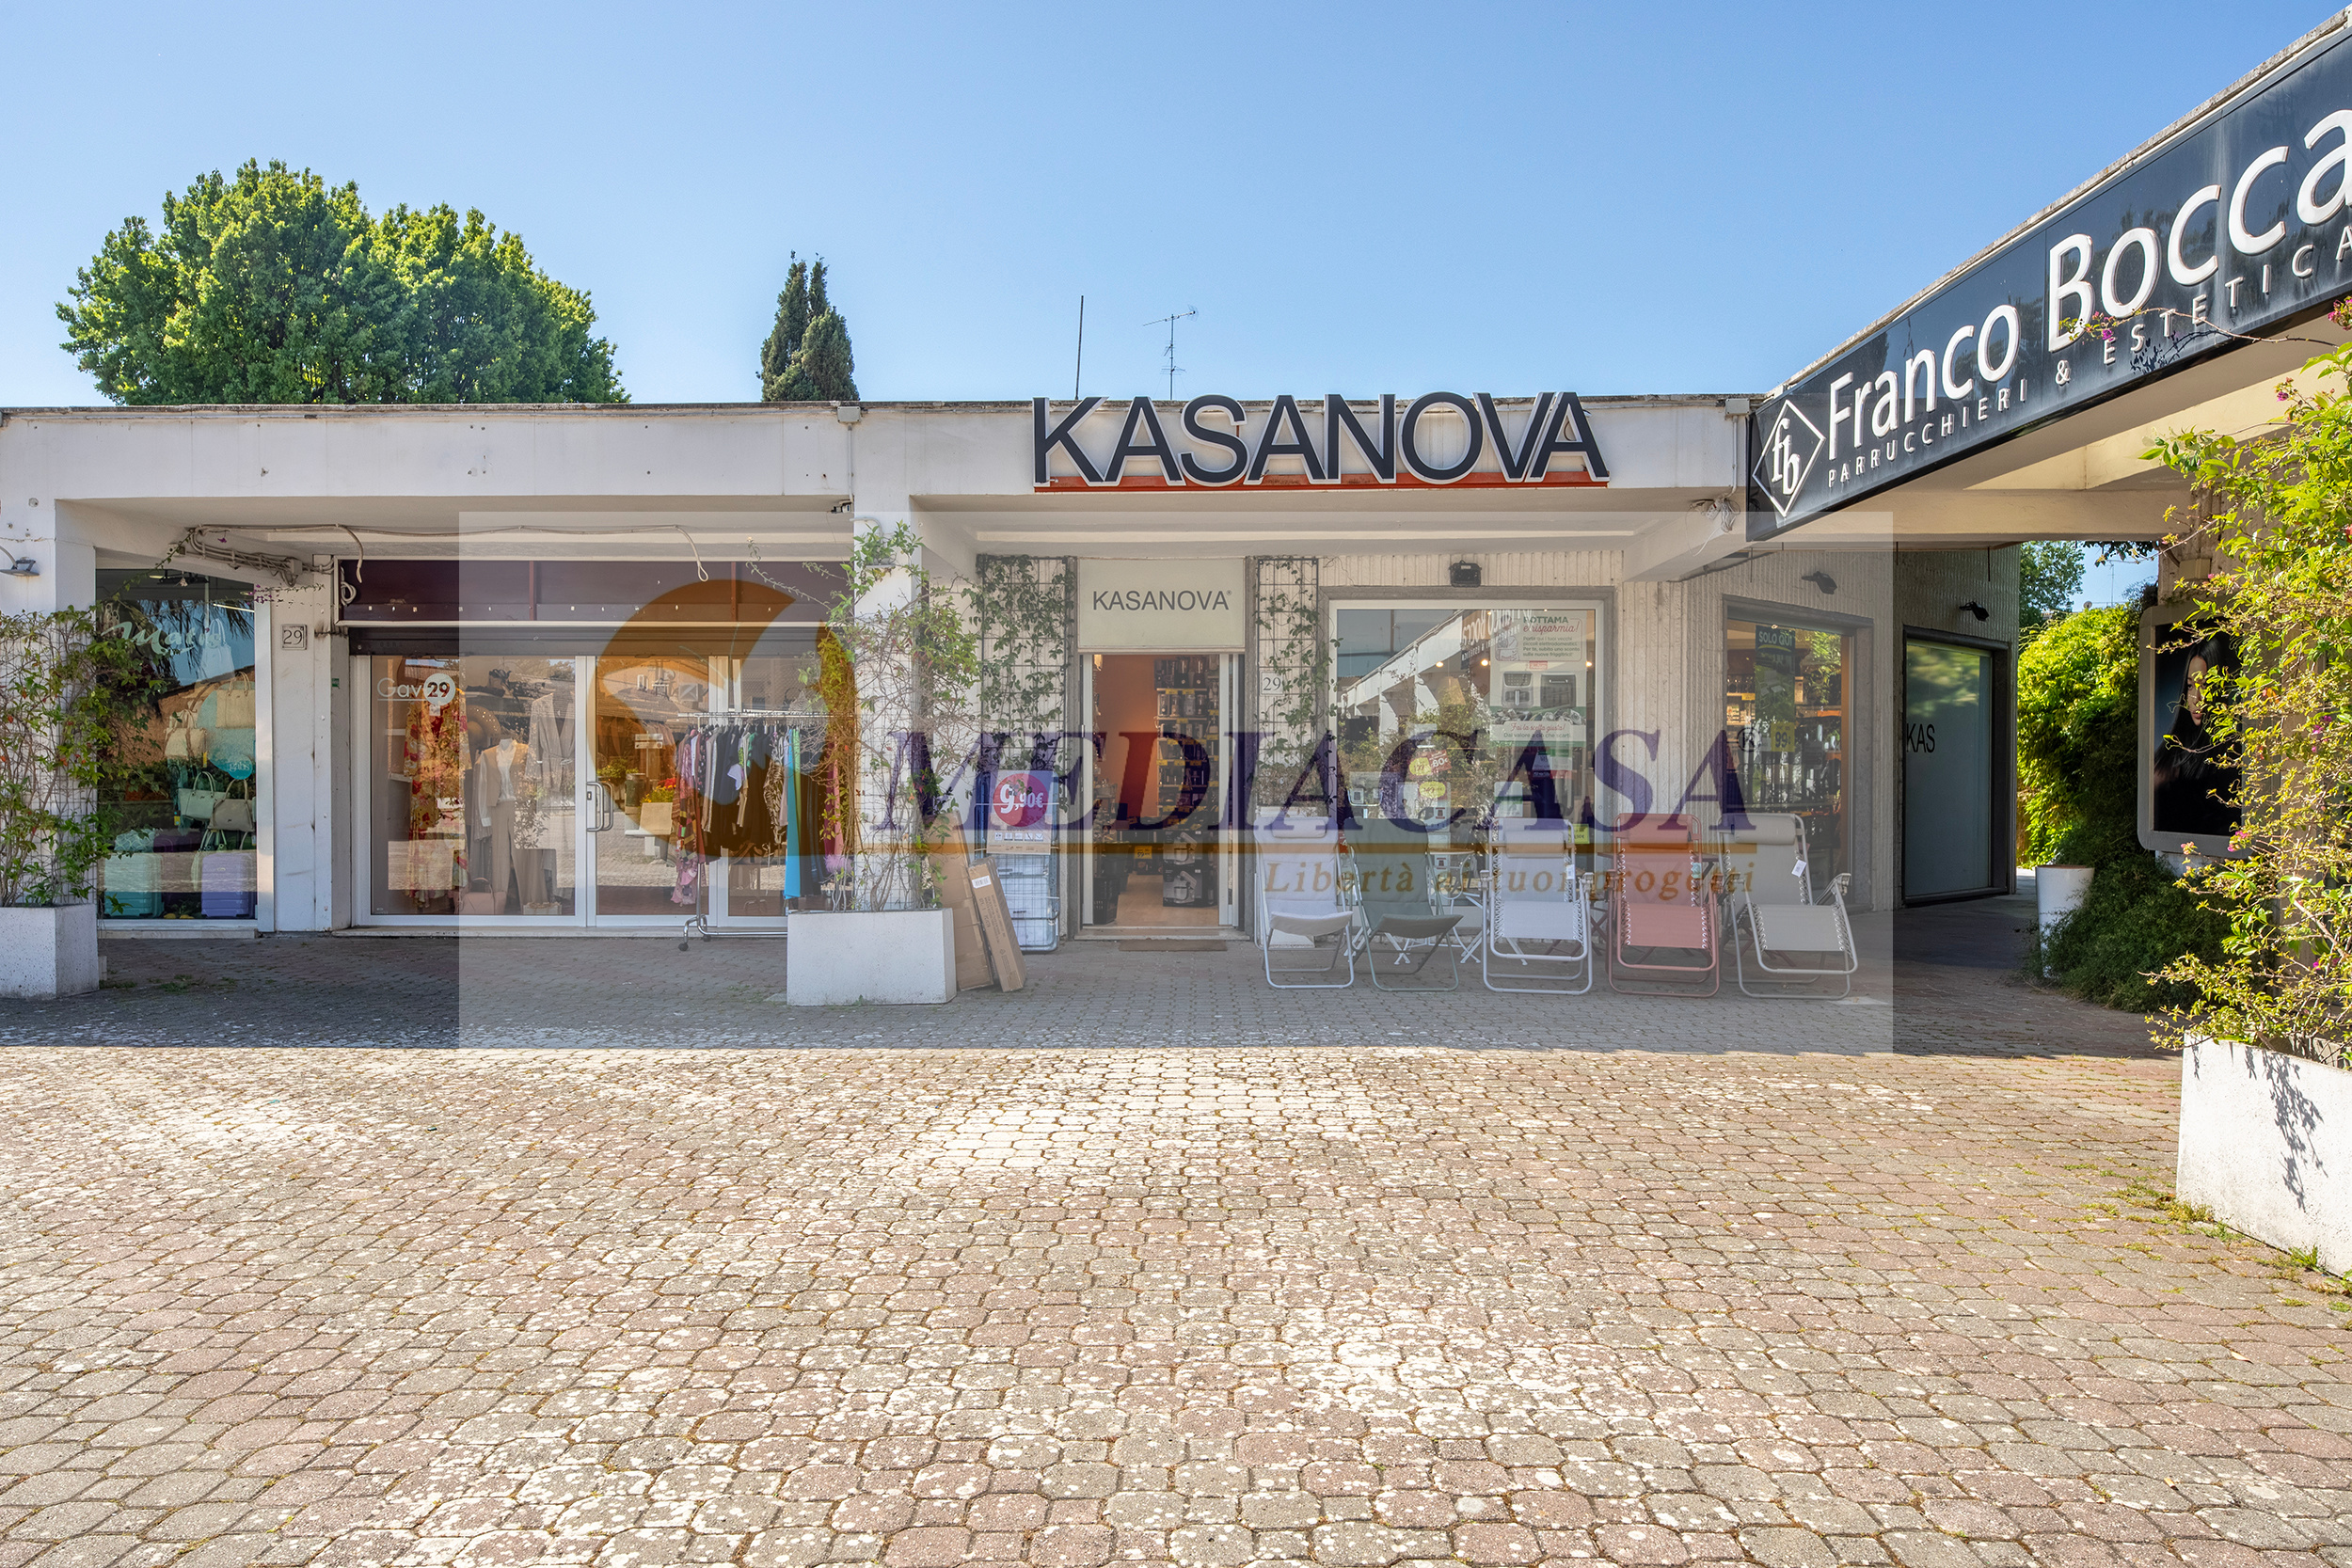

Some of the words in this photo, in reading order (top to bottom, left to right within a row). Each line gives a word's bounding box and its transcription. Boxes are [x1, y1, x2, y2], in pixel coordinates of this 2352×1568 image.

[1828, 303, 2021, 461] Franco
[2047, 108, 2352, 354] Bocca
[1827, 378, 2028, 489] PARRUCCHIERI
[2055, 359, 2071, 387] &
[2103, 225, 2352, 366] ESTETICA
[1033, 391, 1610, 487] KASANOVA
[283, 629, 303, 645] 29
[1758, 631, 1777, 645] SOLO
[376, 677, 423, 698] Gav
[427, 681, 451, 698] 29
[1263, 676, 1281, 691] 29
[1906, 723, 1935, 753] KAS
